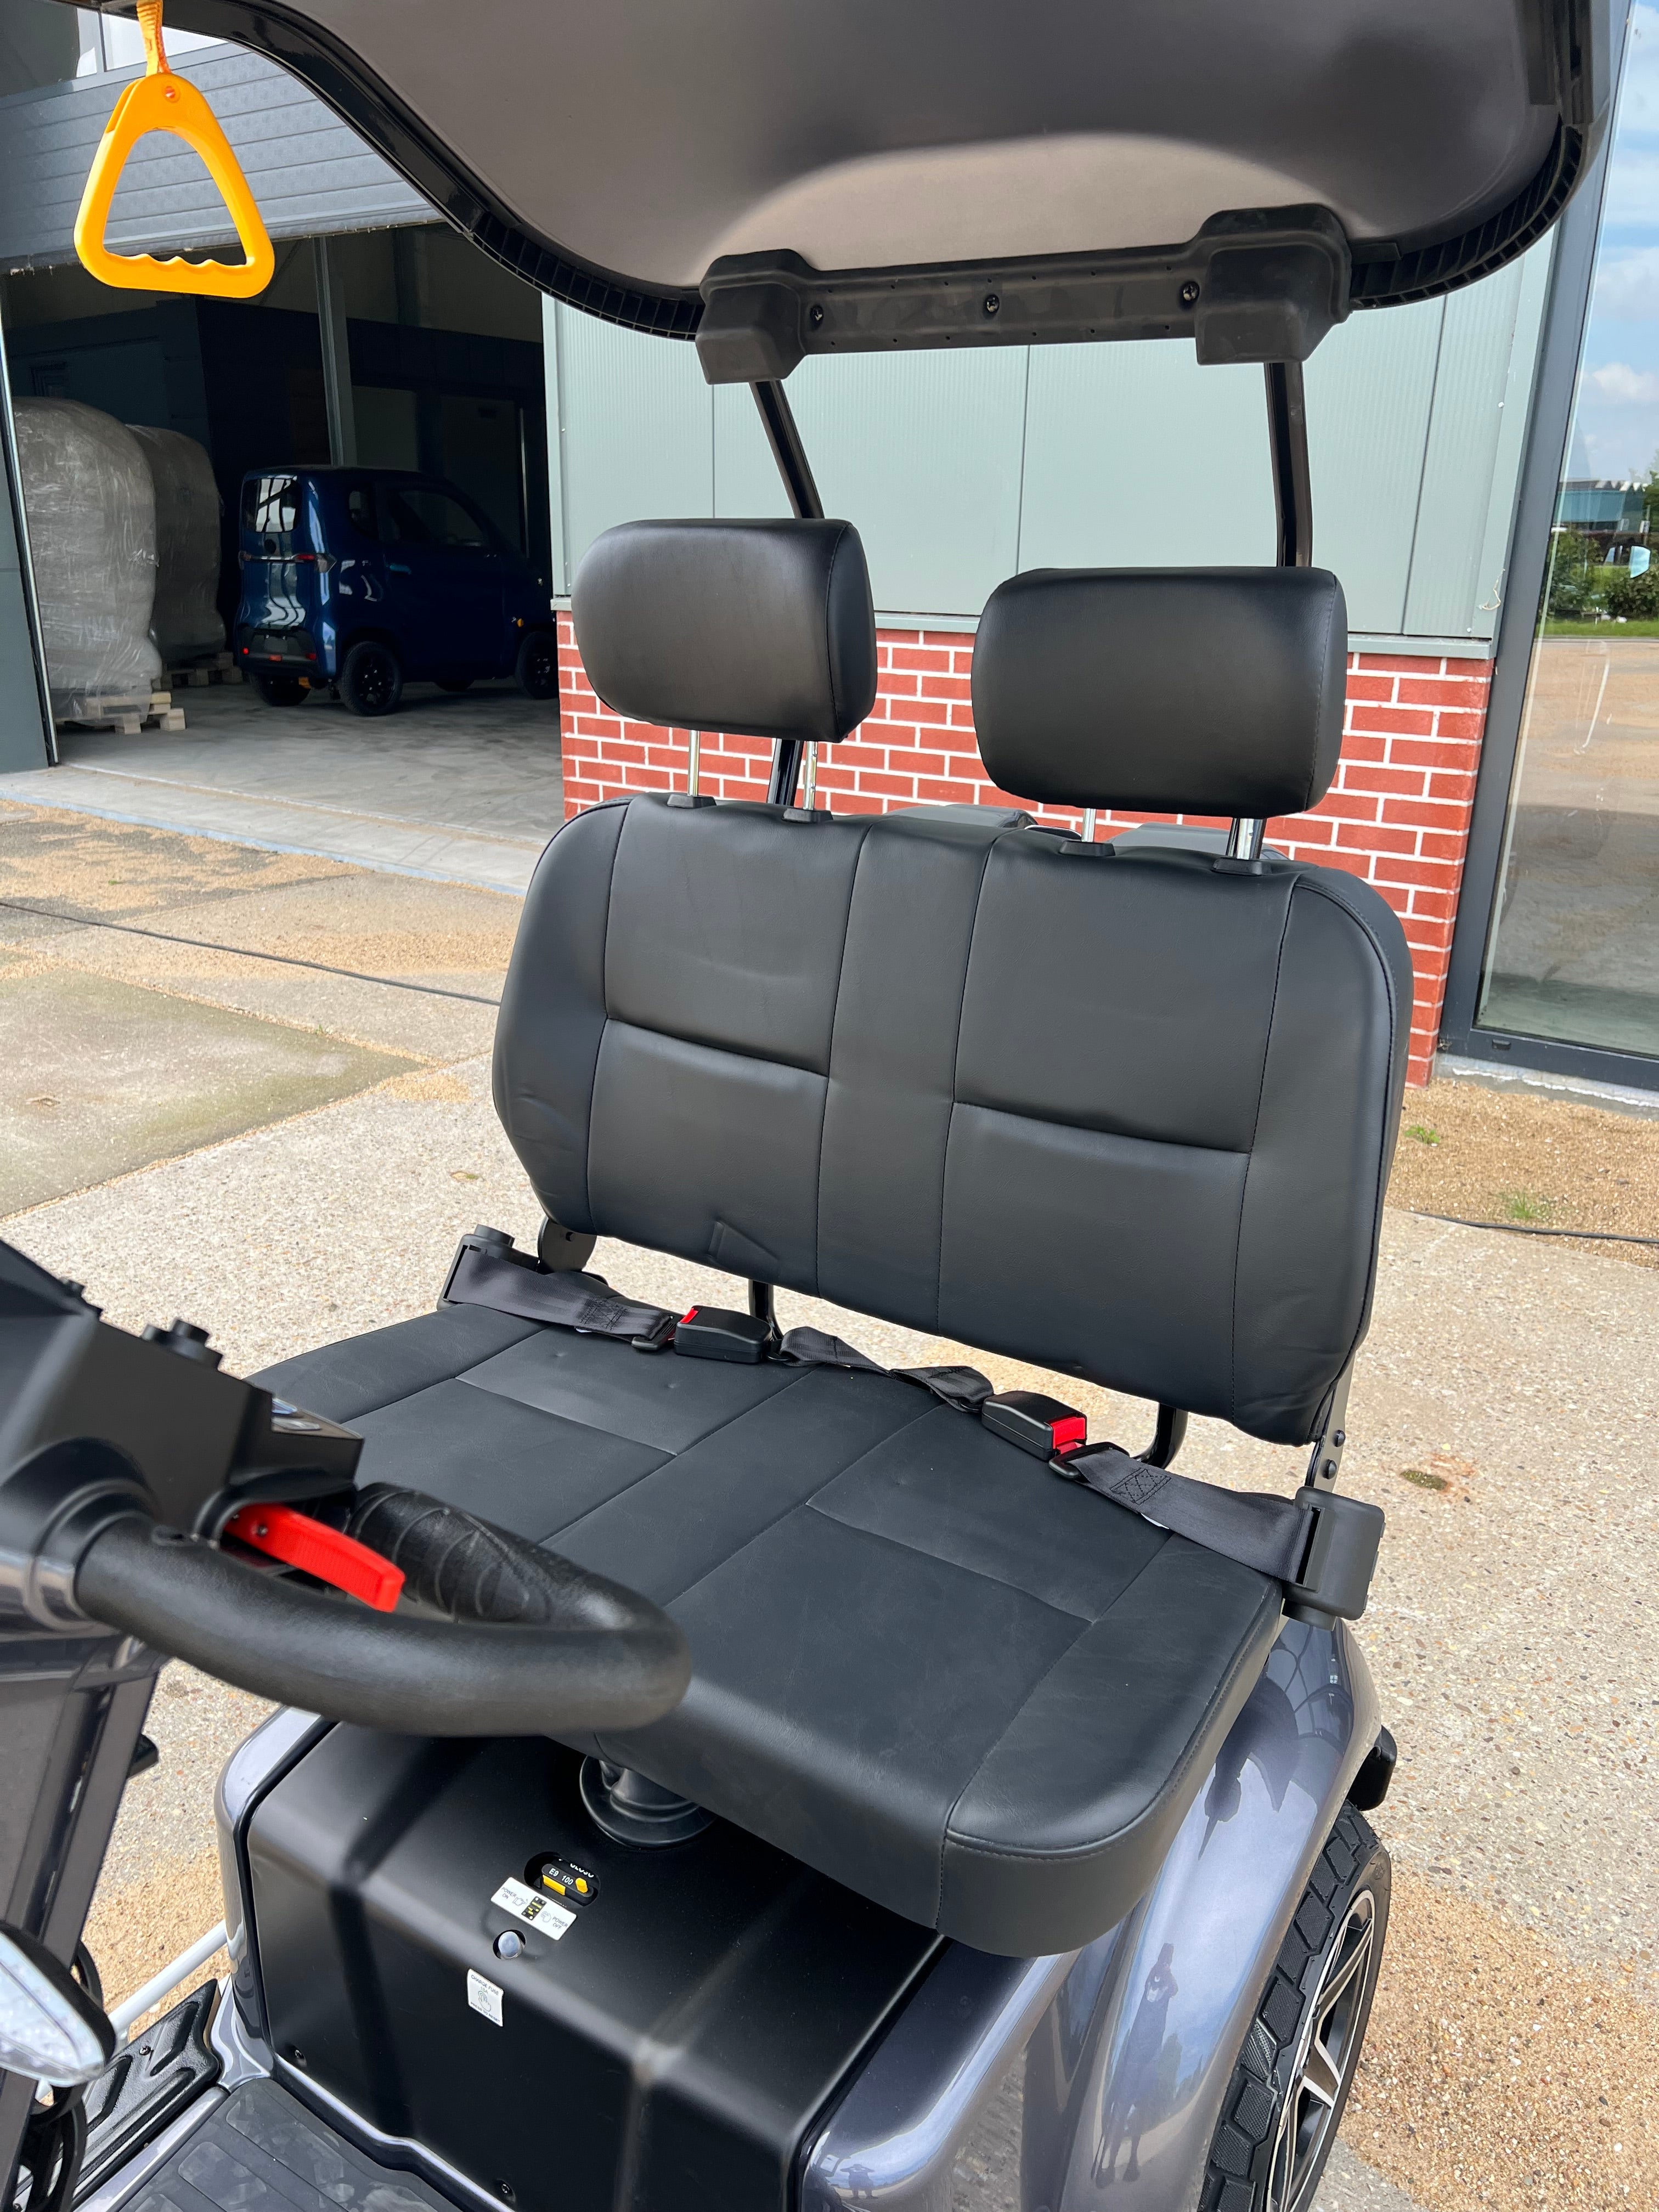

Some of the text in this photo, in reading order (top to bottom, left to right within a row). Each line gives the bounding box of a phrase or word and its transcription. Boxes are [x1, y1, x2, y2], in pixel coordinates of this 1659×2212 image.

[561, 1875, 574, 1885] 100
[501, 1887, 517, 1898] POWER
[552, 1916, 568, 1927] POWER
[471, 1974, 499, 1996] CHARGE FUSE
